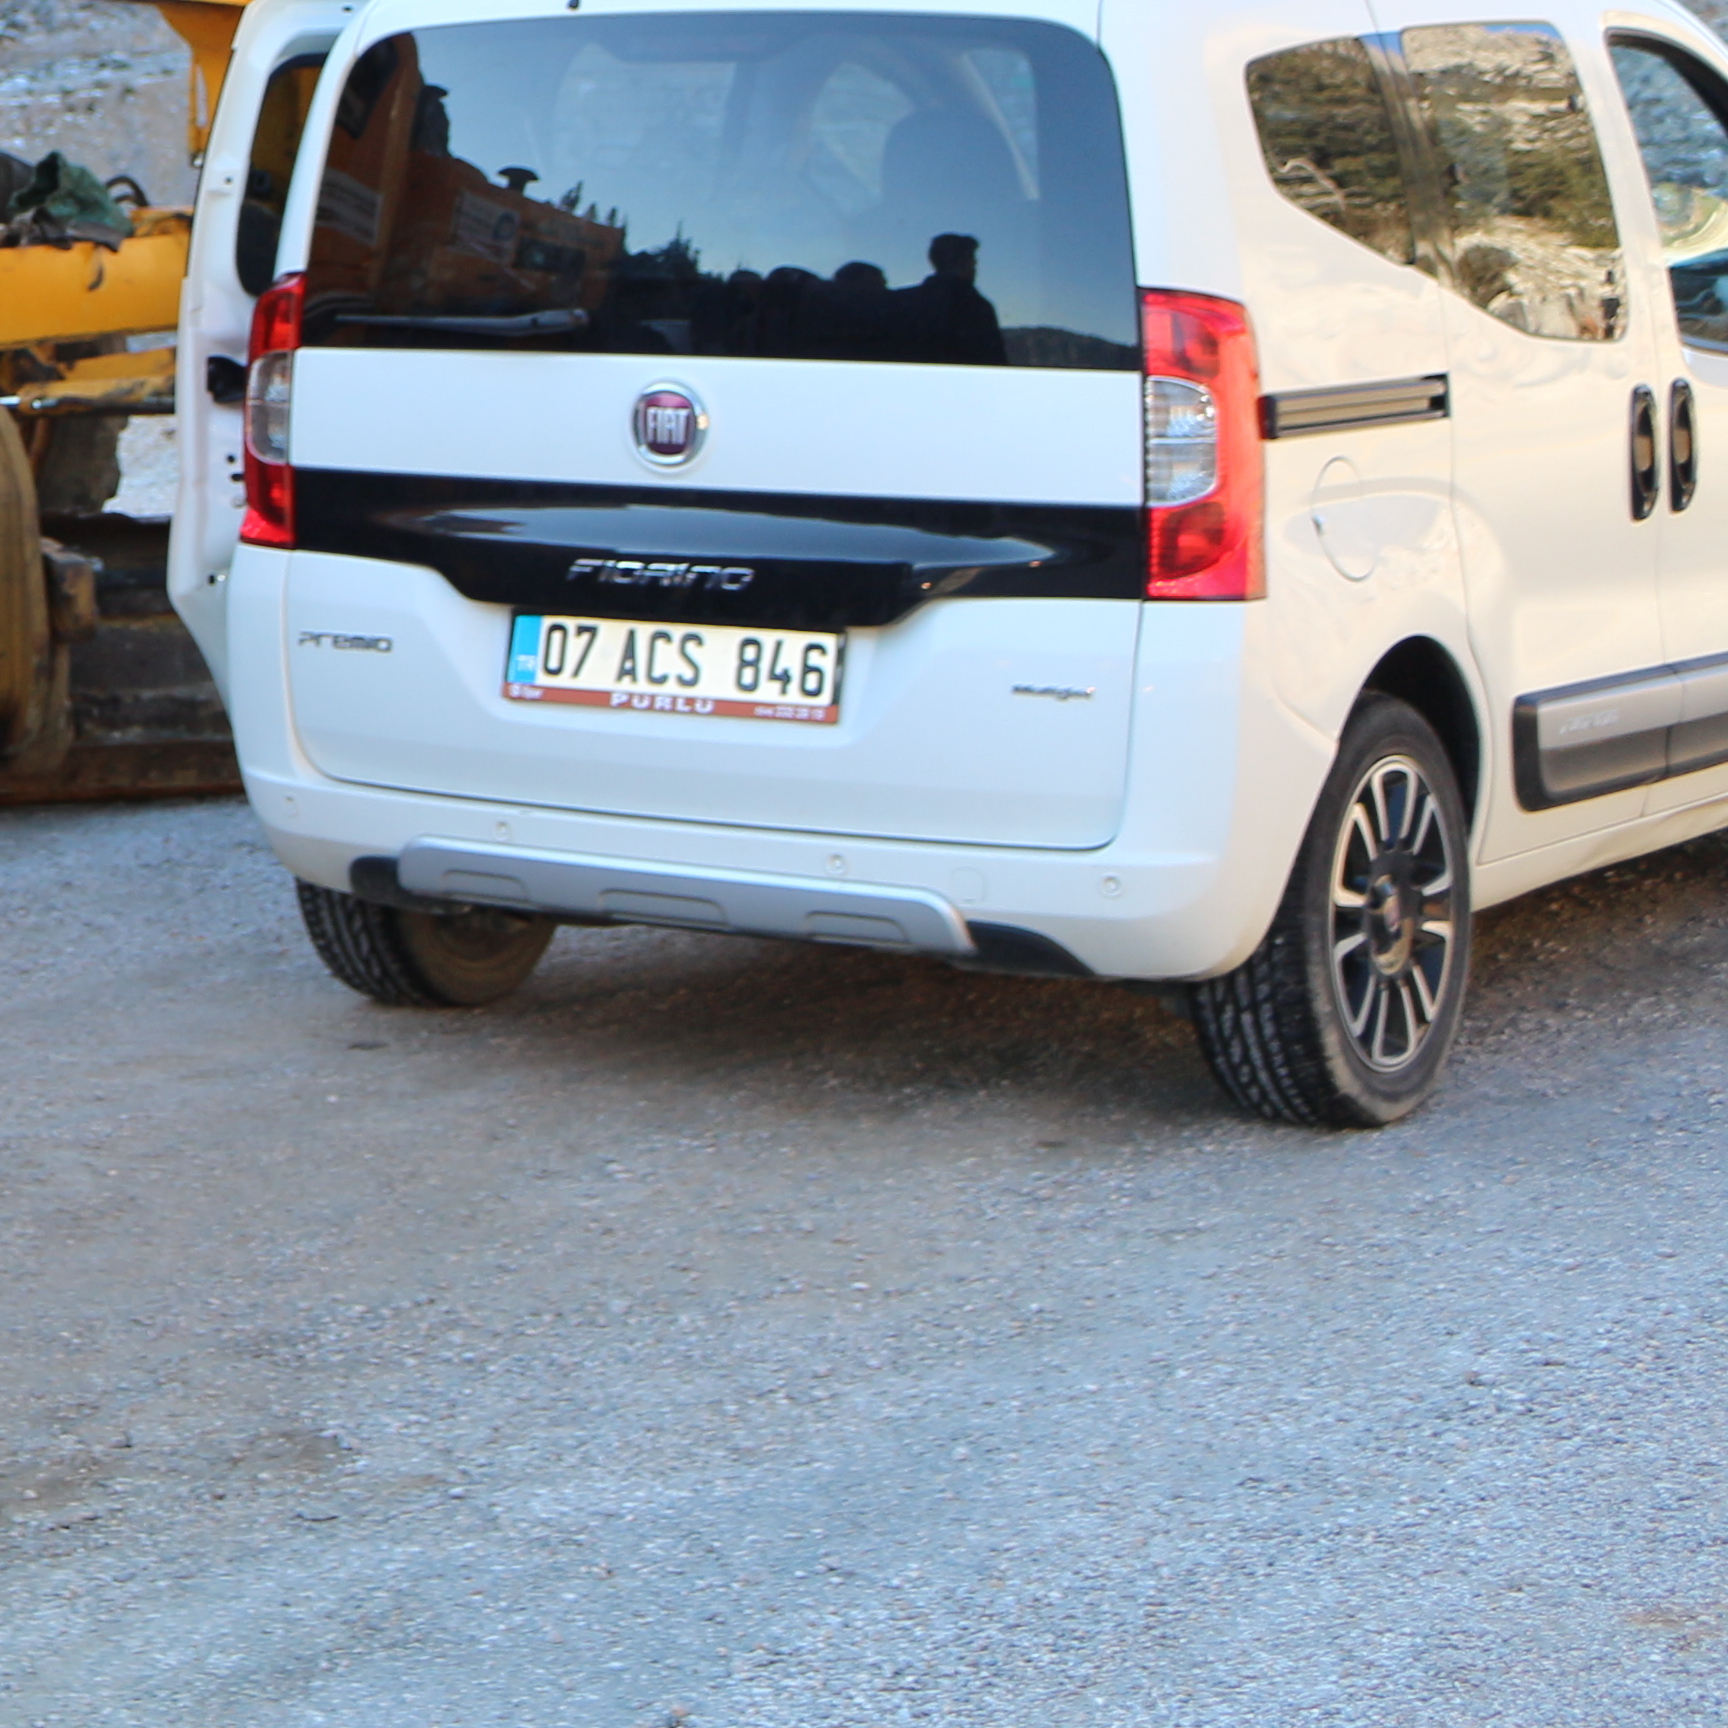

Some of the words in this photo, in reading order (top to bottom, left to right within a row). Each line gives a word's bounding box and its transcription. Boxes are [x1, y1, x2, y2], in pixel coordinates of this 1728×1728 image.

[646, 407, 691, 445] FIAT
[543, 622, 598, 678] 07
[616, 627, 705, 687] ACS
[736, 637, 827, 698] 846
